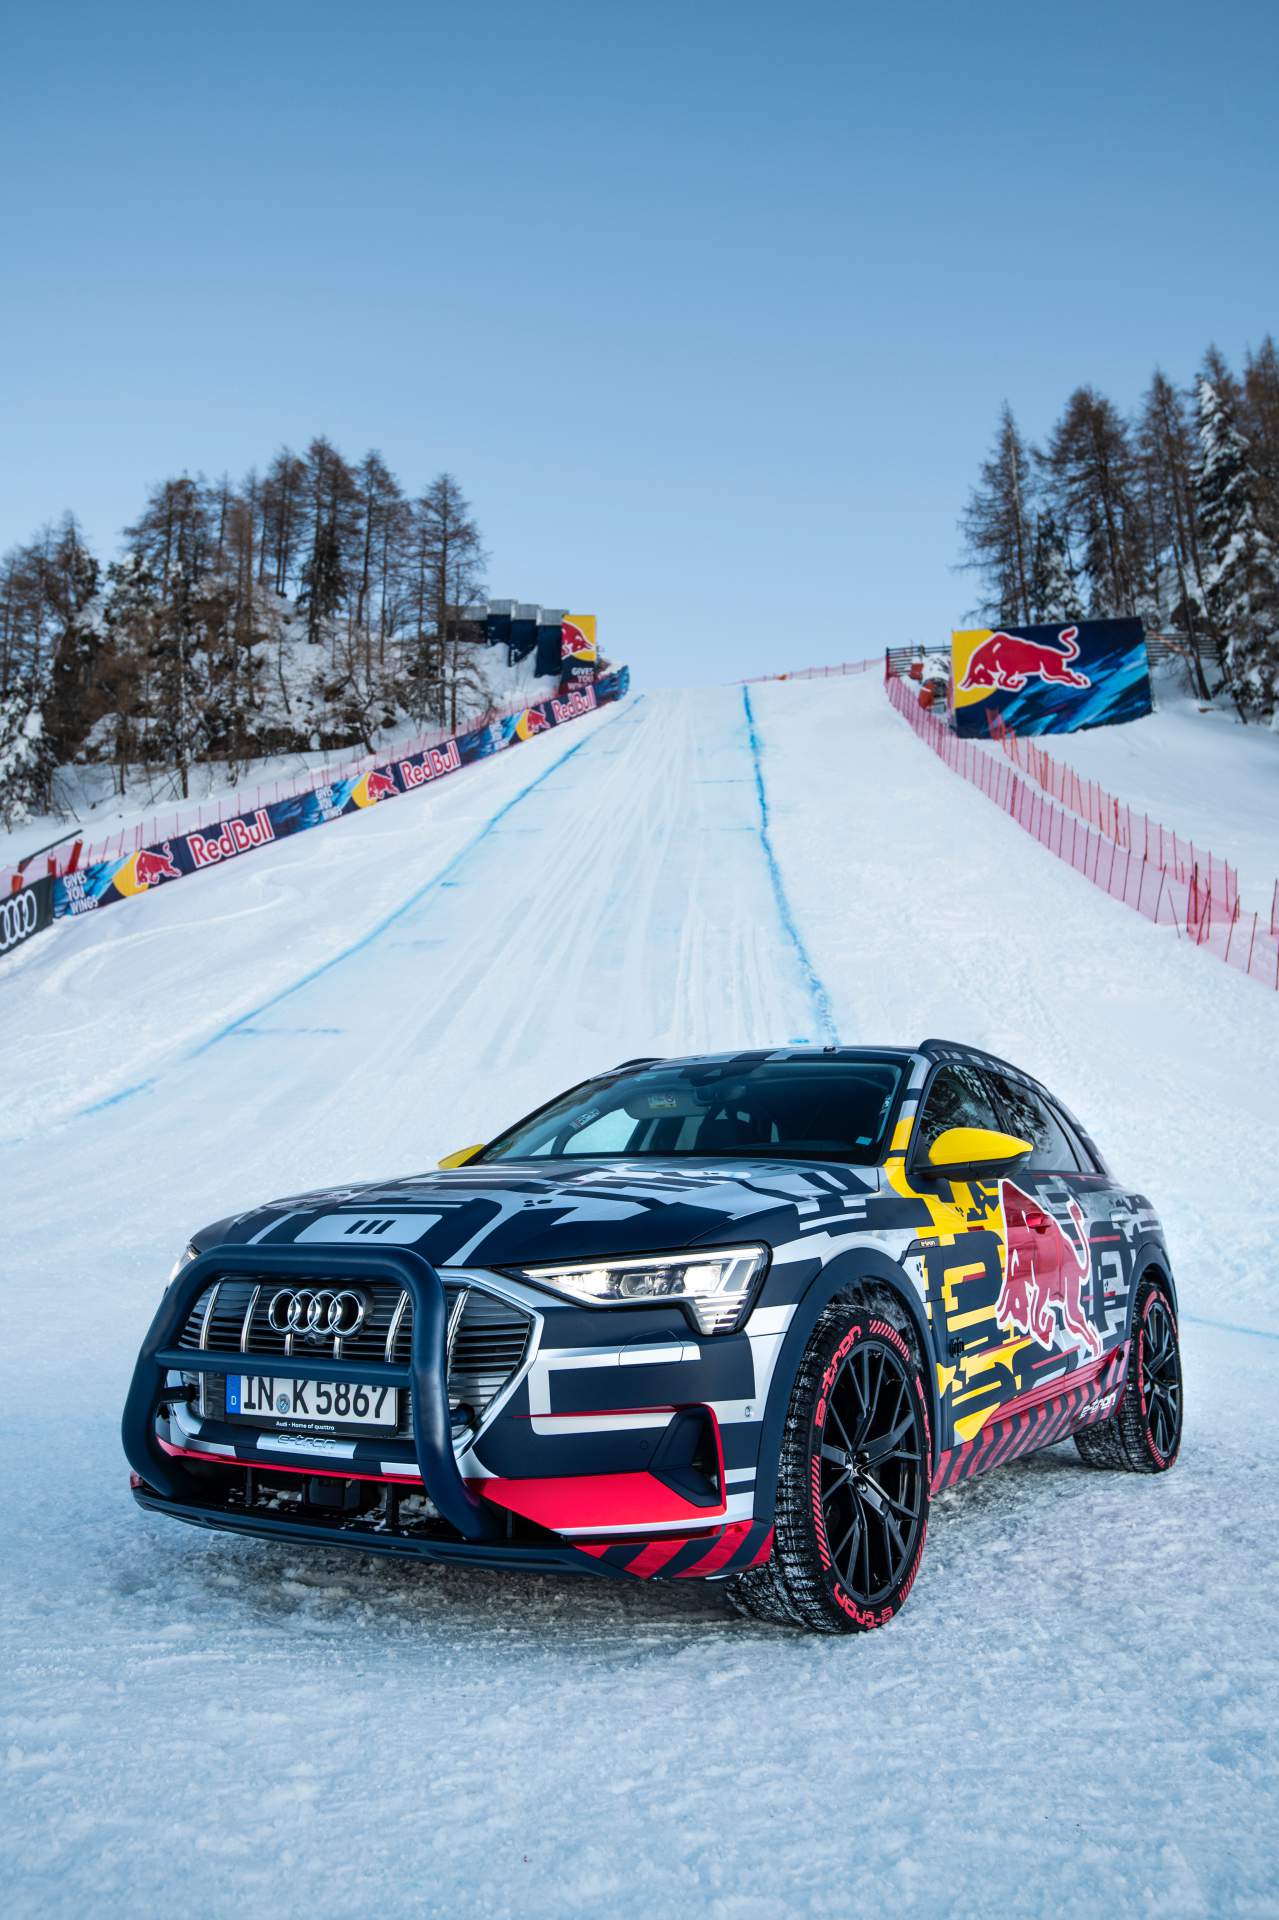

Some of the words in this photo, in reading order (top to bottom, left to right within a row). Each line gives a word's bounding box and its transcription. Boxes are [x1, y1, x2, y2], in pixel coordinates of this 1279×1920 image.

[63, 871, 87, 889] GIVES
[67, 886, 84, 900] YOU
[70, 896, 98, 914] WINGS
[815, 1325, 862, 1427] e-tron
[231, 1395, 237, 1405] D
[243, 1375, 274, 1411] IN
[292, 1379, 309, 1414] K
[316, 1382, 388, 1419] 5867
[1079, 1392, 1116, 1419] e-tron
[277, 1434, 337, 1448] e-tron
